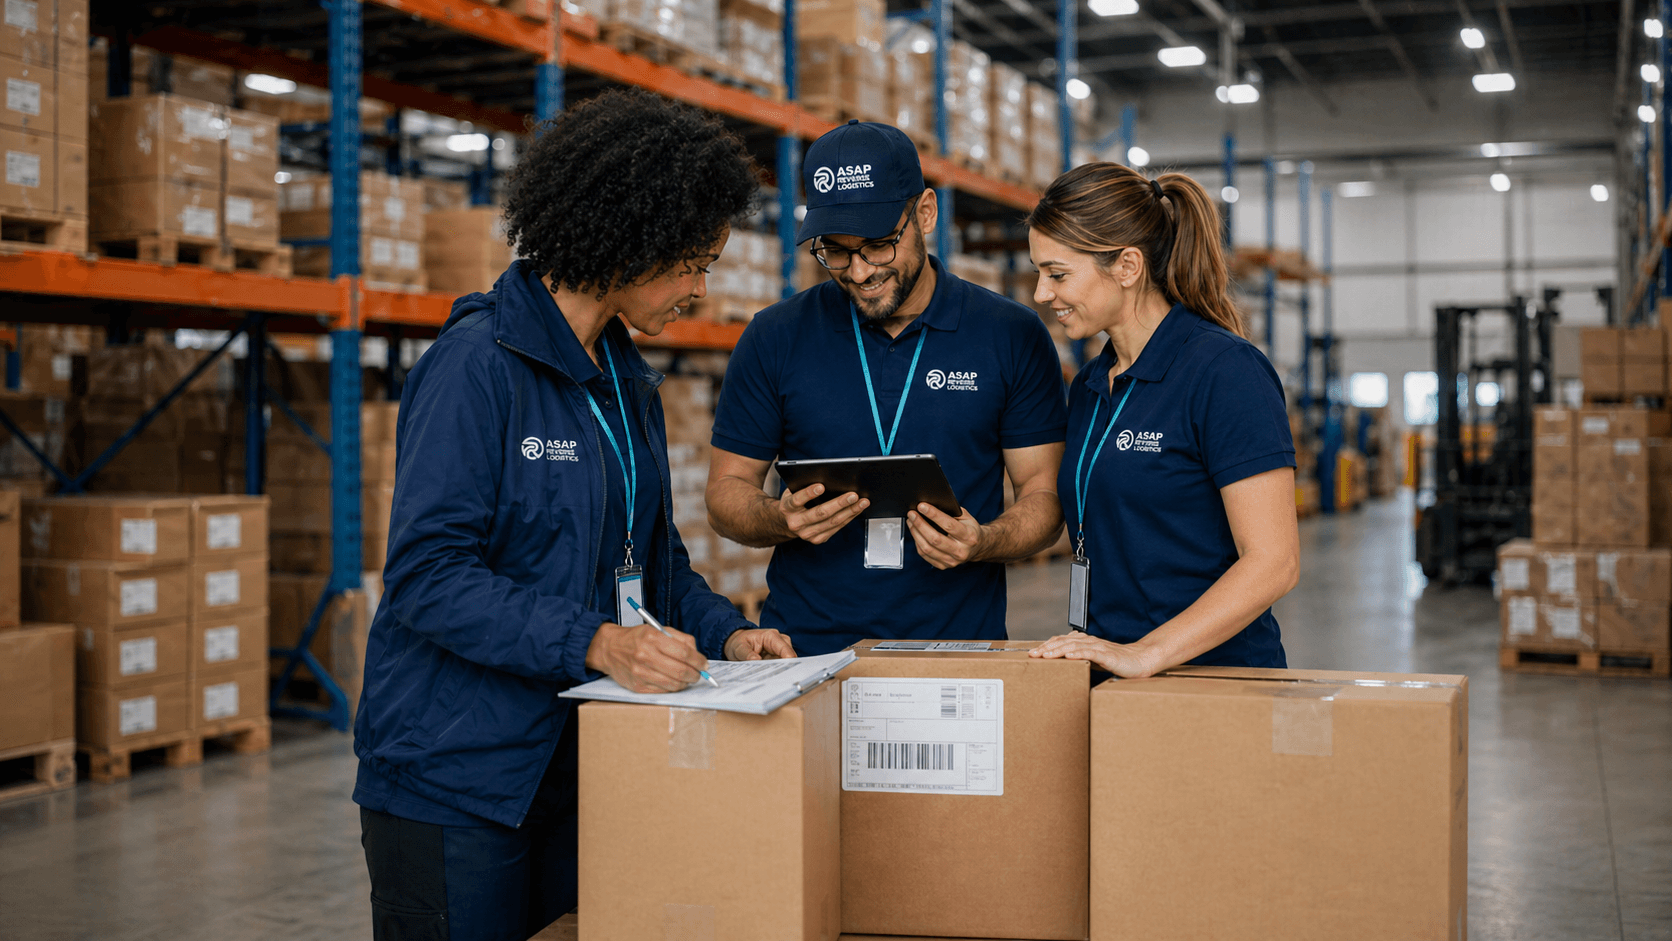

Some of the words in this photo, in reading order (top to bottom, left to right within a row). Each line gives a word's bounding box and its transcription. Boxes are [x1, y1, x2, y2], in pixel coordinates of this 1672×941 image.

[837, 164, 872, 177] ASAP
[948, 371, 977, 380] ASAP
[1136, 431, 1163, 441] ASAP
[546, 439, 577, 449] ASAP
